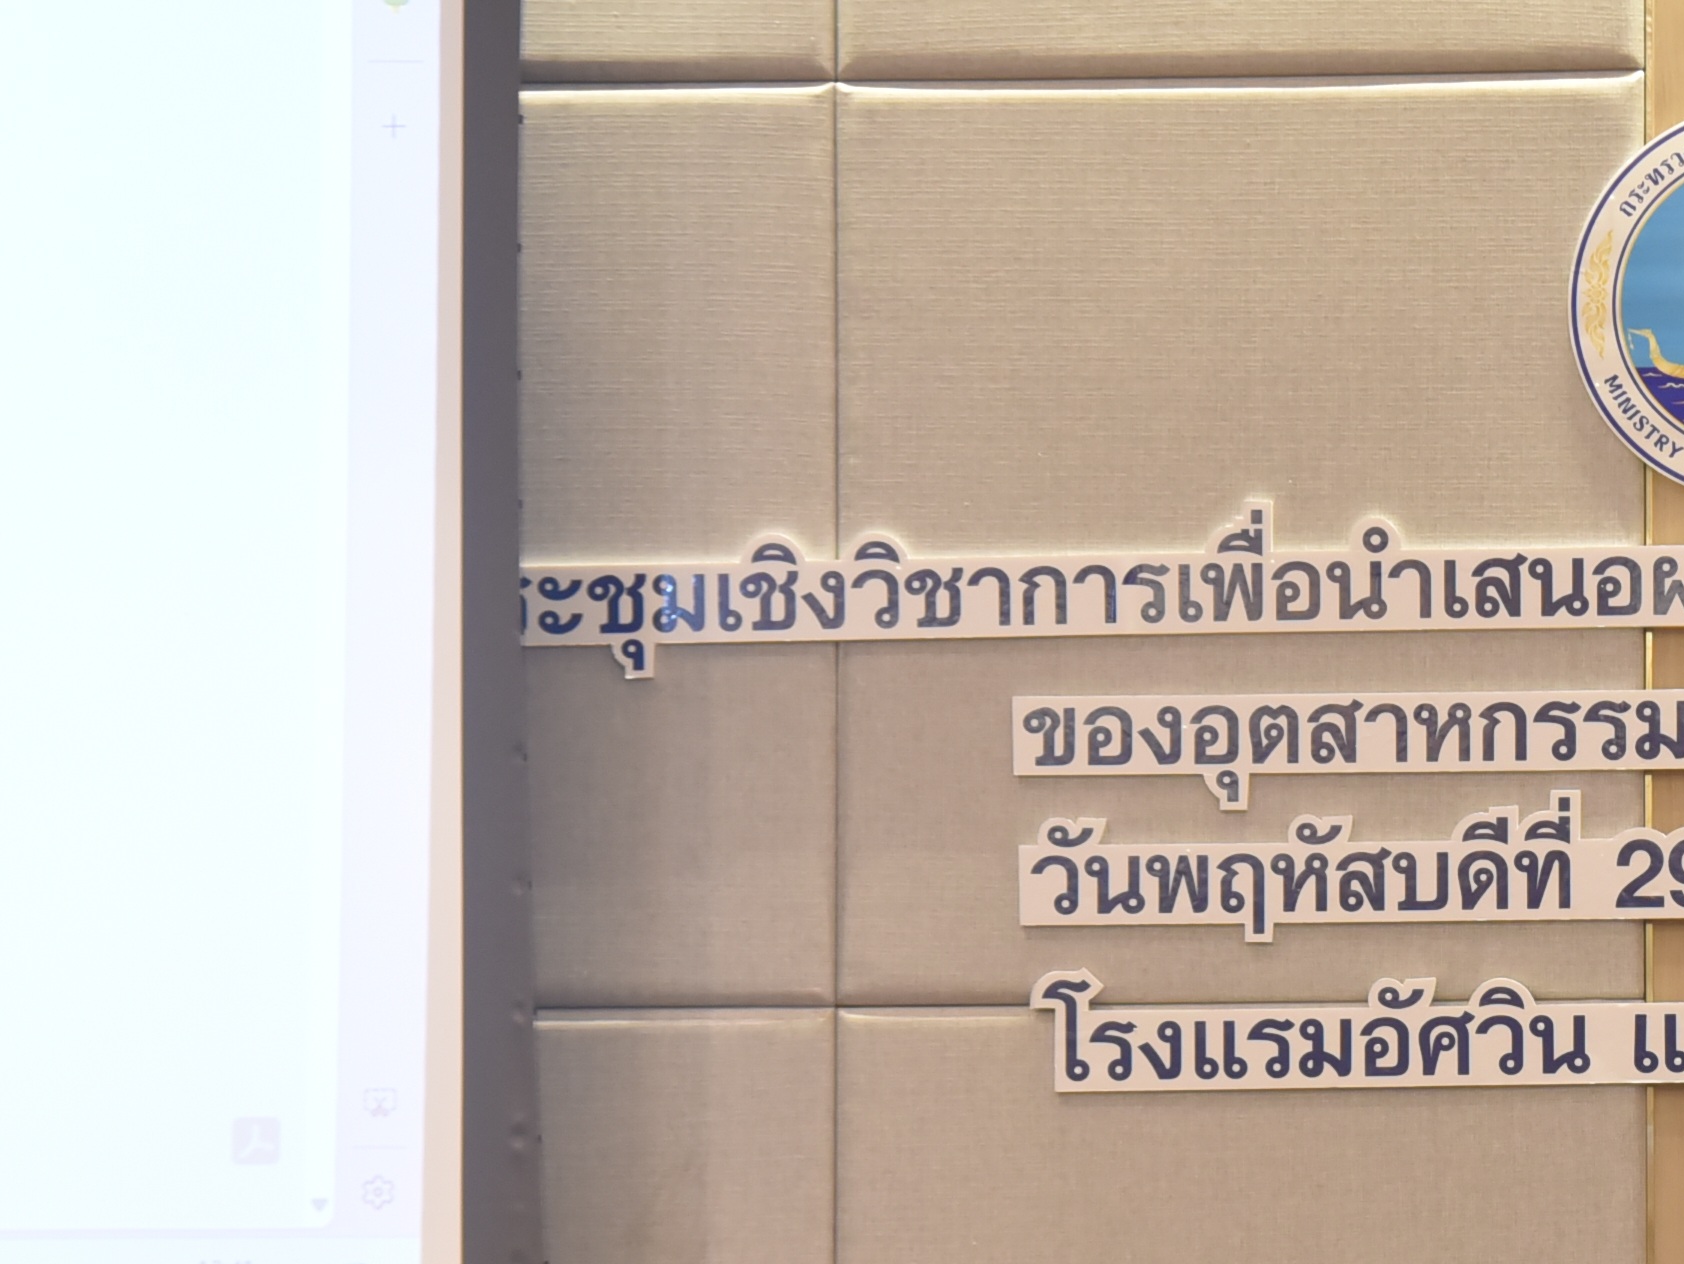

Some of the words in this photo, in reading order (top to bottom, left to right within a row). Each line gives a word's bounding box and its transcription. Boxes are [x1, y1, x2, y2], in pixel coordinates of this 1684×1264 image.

[1604, 374, 1684, 459] MINISTRY
[1029, 796, 1572, 935] วันพฤหัสบดีที่
[1042, 977, 1591, 1081] โรงแรมอัศวิน
